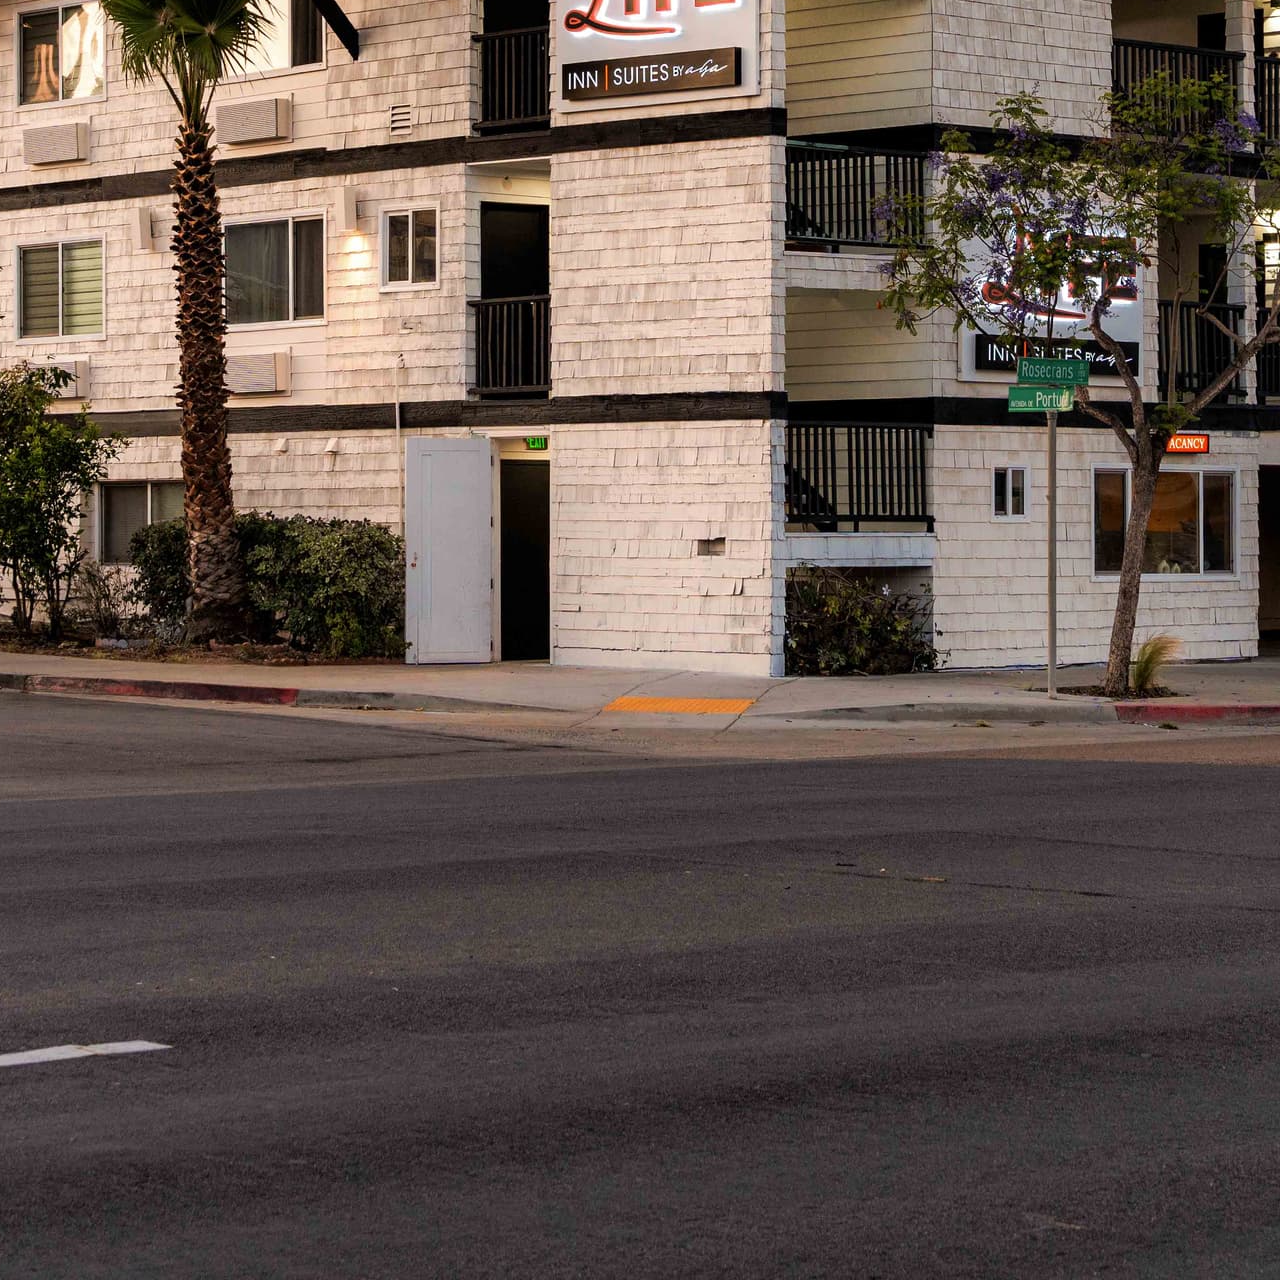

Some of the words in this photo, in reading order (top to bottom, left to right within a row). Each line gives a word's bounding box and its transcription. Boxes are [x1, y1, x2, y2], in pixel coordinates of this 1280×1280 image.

[568, 70, 598, 90] INN
[613, 63, 669, 86] SUITES
[673, 65, 685, 77] BY
[988, 343, 1017, 362] INN
[1085, 351, 1095, 363] BY
[1021, 361, 1074, 379] Rosecrans
[529, 437, 545, 449] EXIT
[1169, 437, 1205, 449] ACANCY
